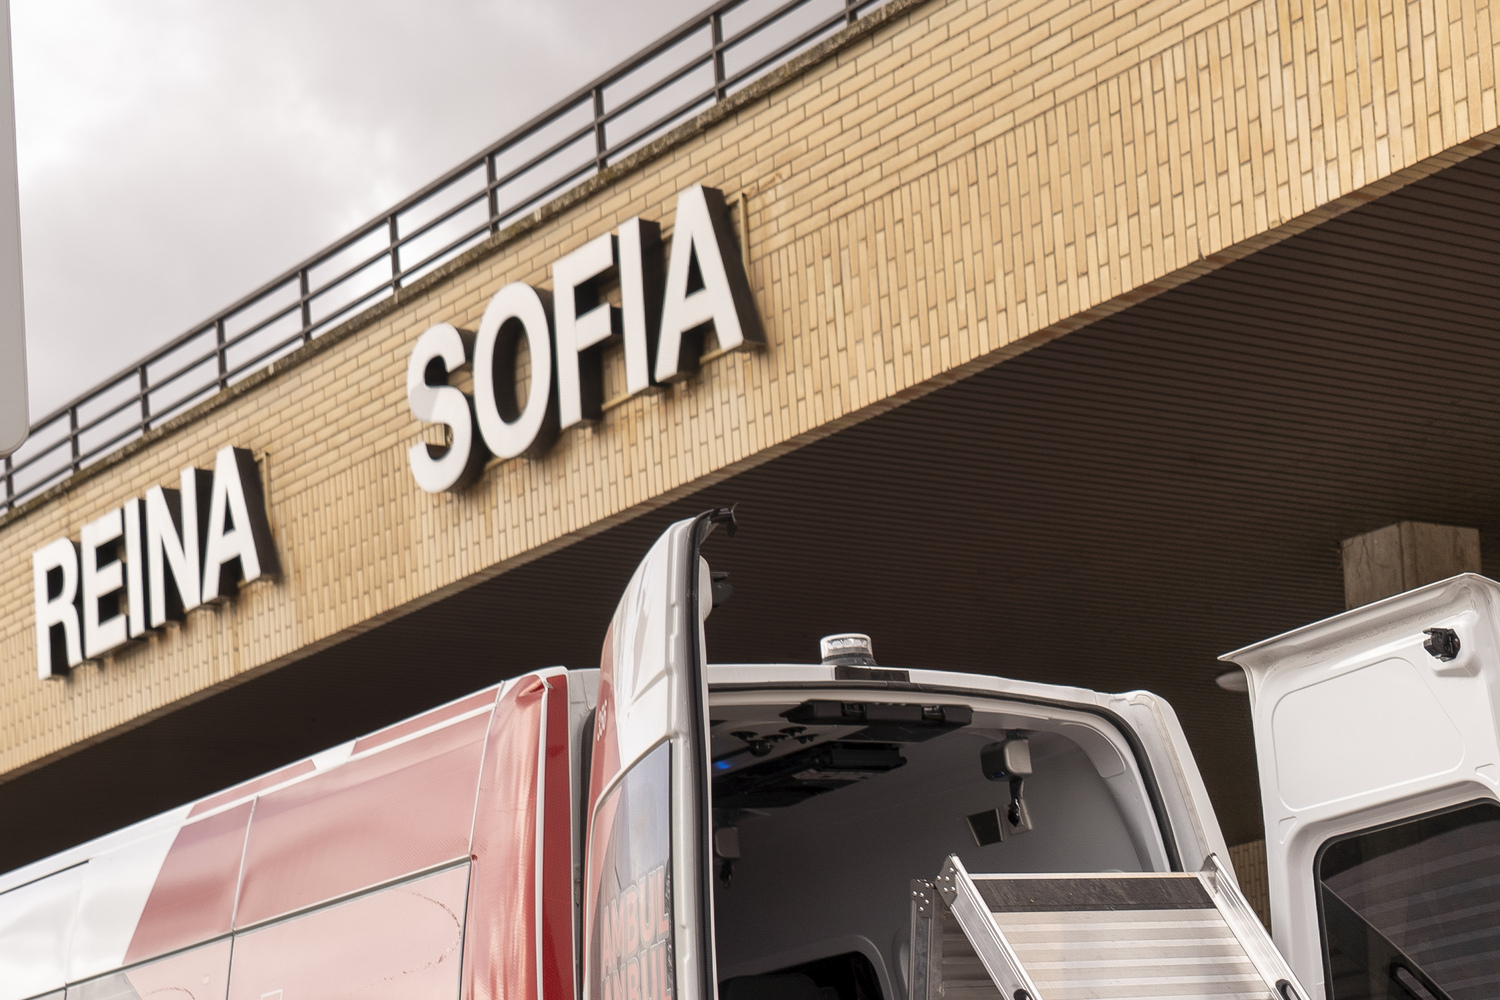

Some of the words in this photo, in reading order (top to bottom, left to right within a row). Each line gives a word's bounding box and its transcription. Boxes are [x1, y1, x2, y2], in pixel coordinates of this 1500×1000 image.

[407, 184, 746, 494] SOFIA
[32, 445, 263, 680] REINA
[602, 870, 670, 977] AMBUL
